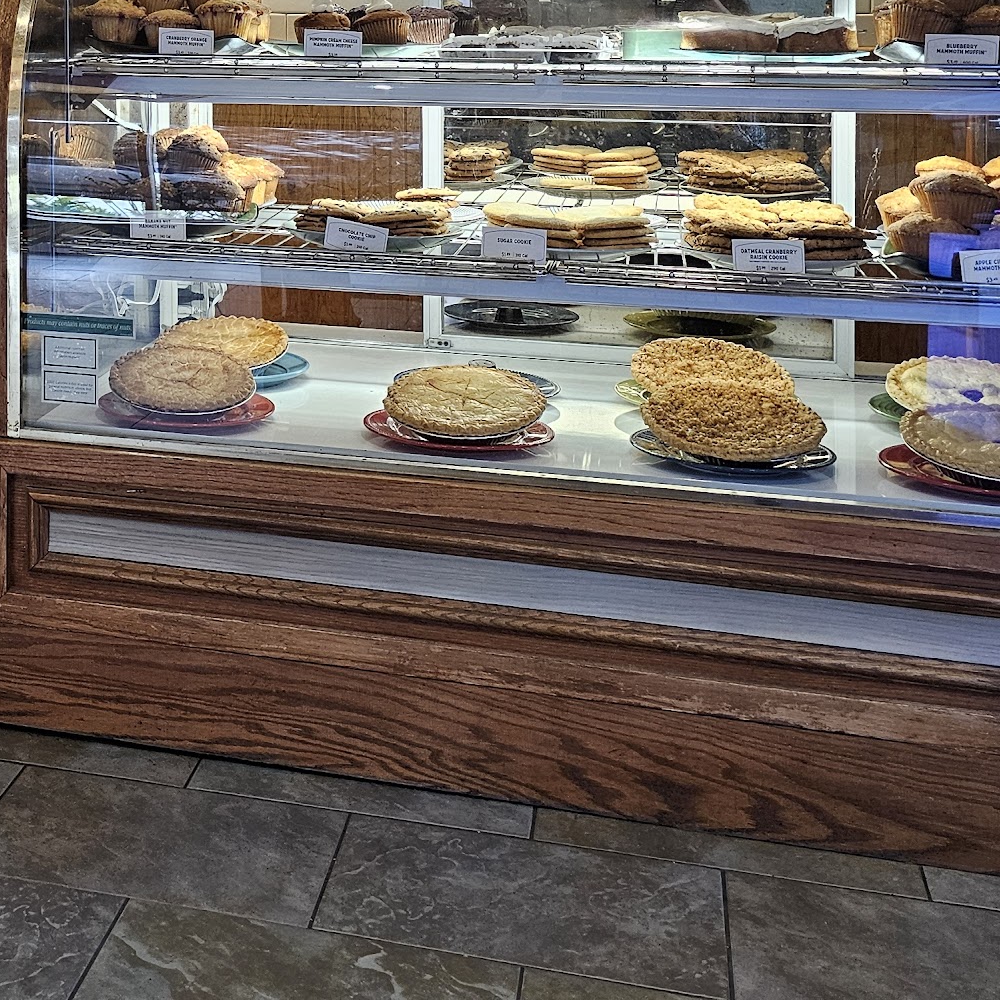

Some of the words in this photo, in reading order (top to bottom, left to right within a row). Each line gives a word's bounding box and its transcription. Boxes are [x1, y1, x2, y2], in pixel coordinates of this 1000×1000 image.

[338, 227, 364, 237] CHOCOLATE
[23, 316, 46, 325] Products
[46, 320, 58, 328] may
[58, 319, 78, 327] contain
[113, 323, 120, 331] of
